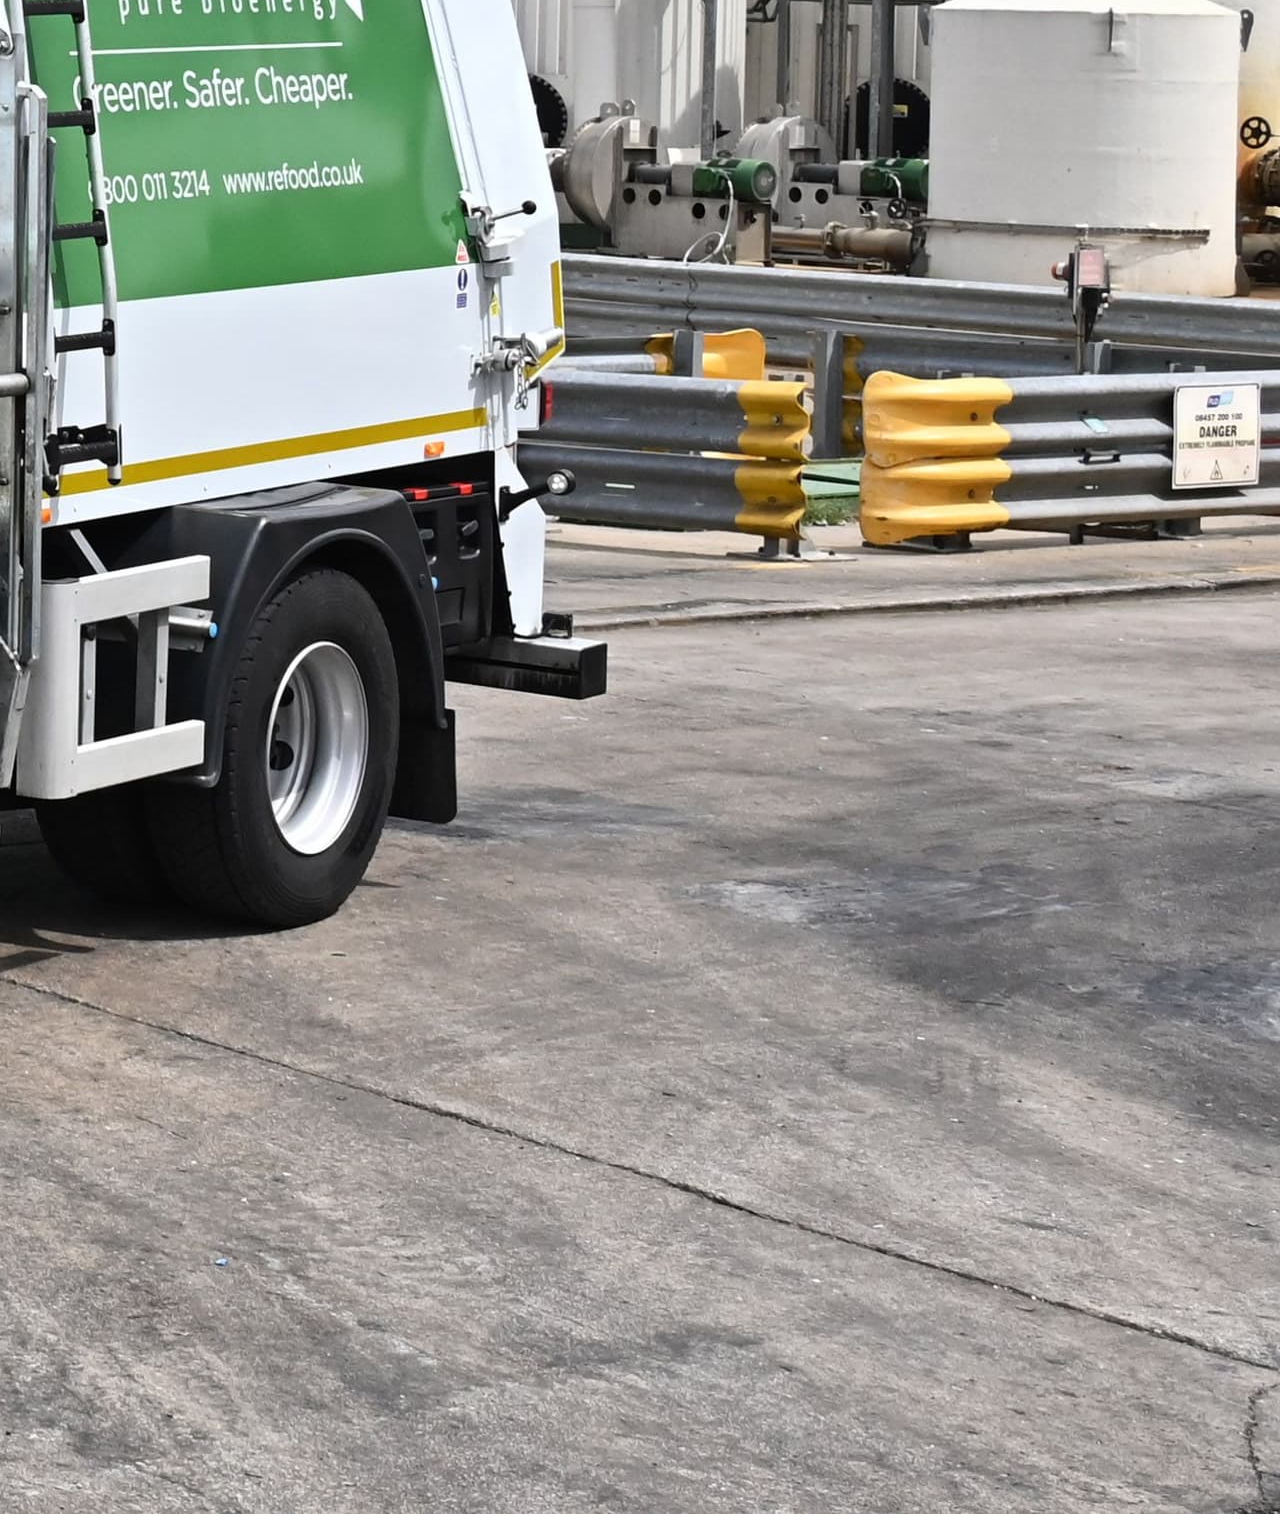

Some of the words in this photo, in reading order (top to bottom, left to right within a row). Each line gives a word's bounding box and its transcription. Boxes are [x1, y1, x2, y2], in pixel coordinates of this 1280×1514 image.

[182, 68, 251, 109] Safer.
[254, 65, 354, 109] Cheaper.
[87, 174, 138, 206] 800
[142, 172, 168, 201] 011
[171, 169, 211, 199] 3214
[222, 157, 364, 195] www.refood.co.uk
[1199, 425, 1238, 438] DANGER
